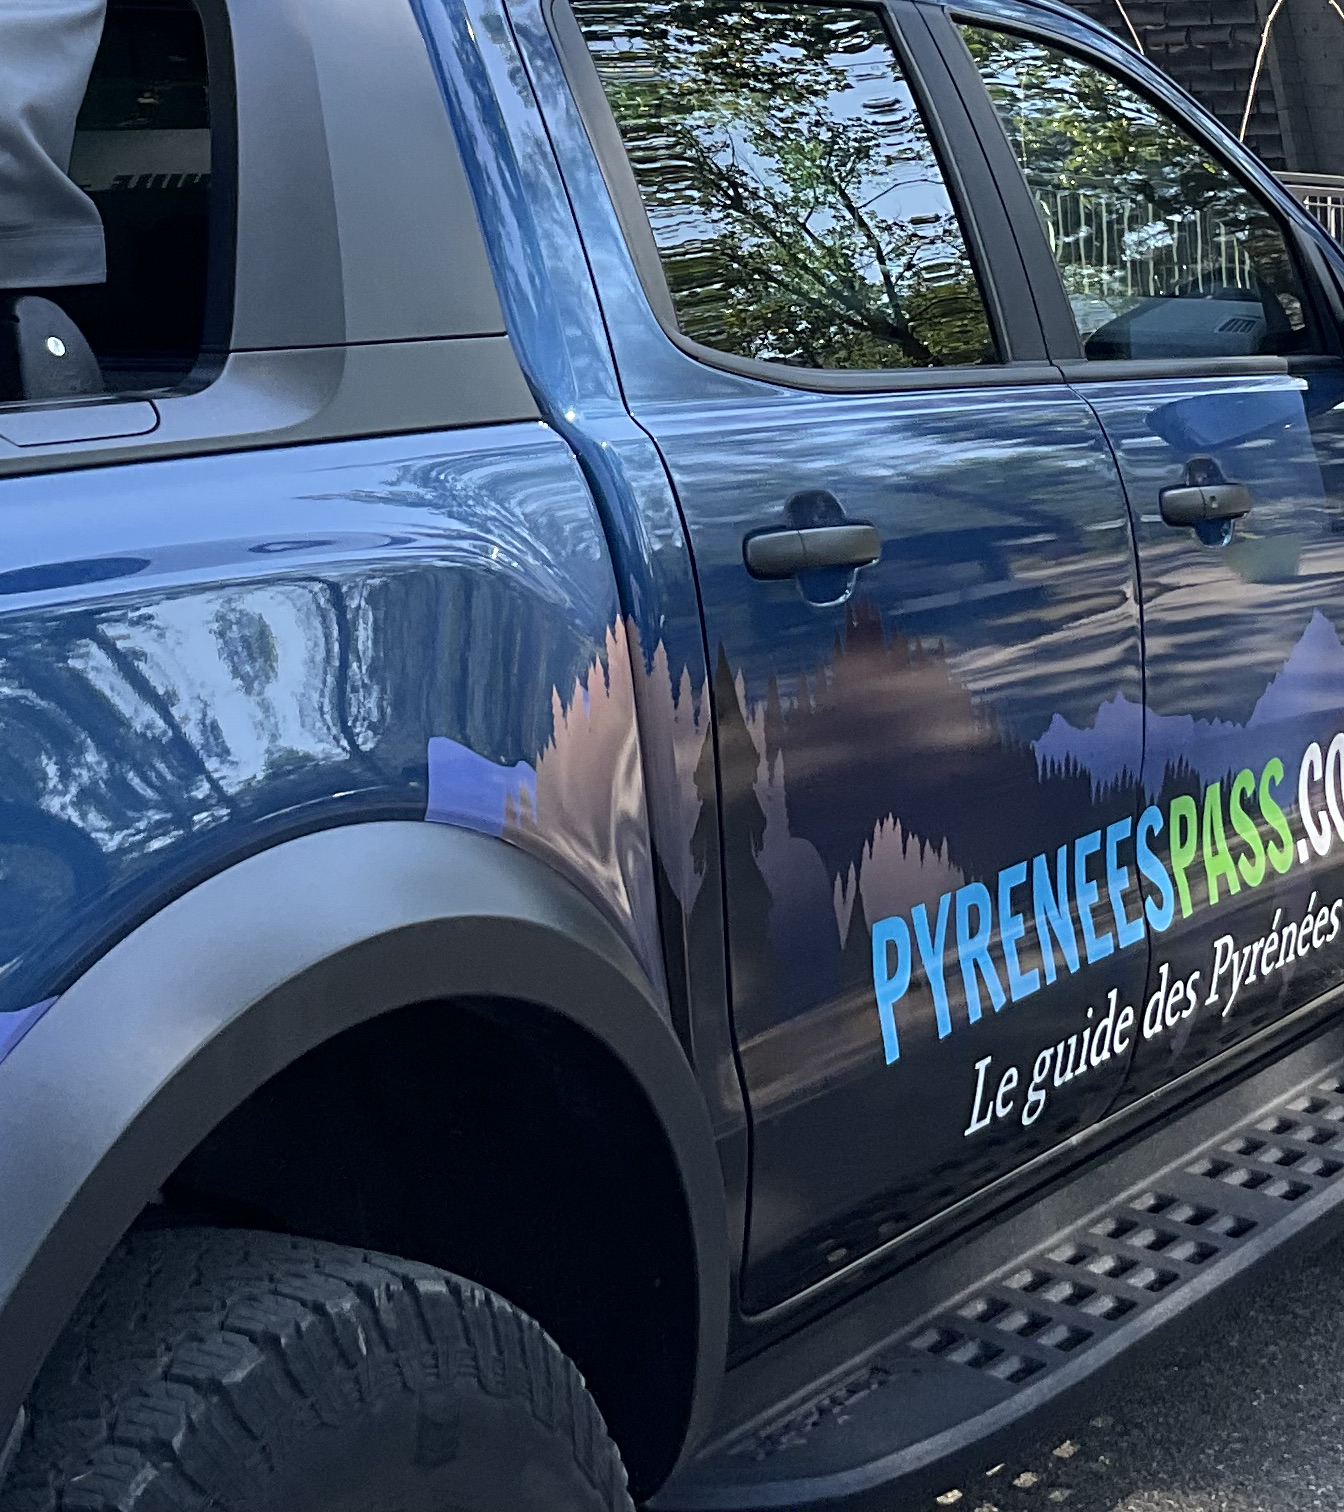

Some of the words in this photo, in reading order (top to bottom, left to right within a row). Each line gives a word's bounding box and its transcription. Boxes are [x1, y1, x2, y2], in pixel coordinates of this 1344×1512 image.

[963, 1055, 1019, 1137] Le
[1021, 988, 1135, 1126] guide
[1142, 962, 1202, 1040] des
[1204, 890, 1344, 1017] Pyrénées
